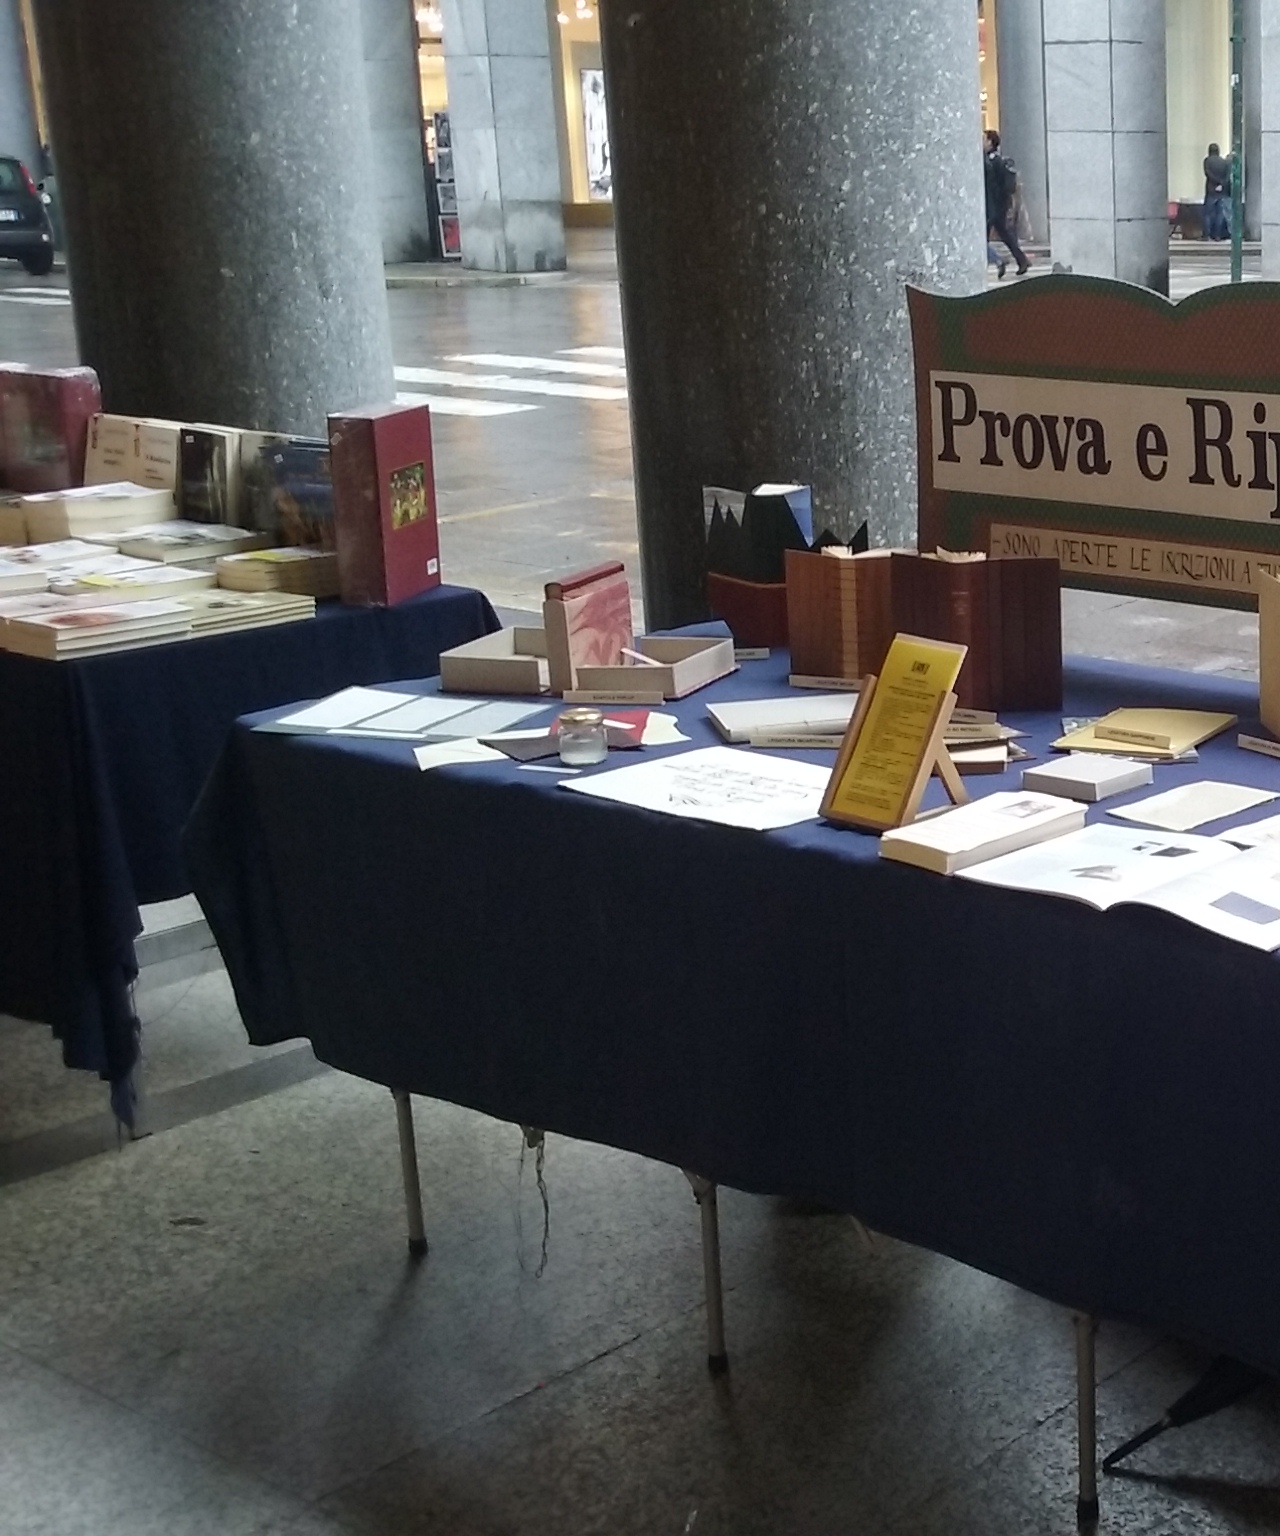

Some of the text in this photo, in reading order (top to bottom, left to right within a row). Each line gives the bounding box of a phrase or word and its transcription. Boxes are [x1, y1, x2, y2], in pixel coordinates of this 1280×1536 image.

[935, 381, 1112, 475] Prova
[1136, 423, 1169, 481] e
[1003, 532, 1041, 558] SONO
[1053, 538, 1118, 569] APERTE
[1131, 547, 1151, 572] LE
[1161, 550, 1235, 581] ISCRIZIONI
